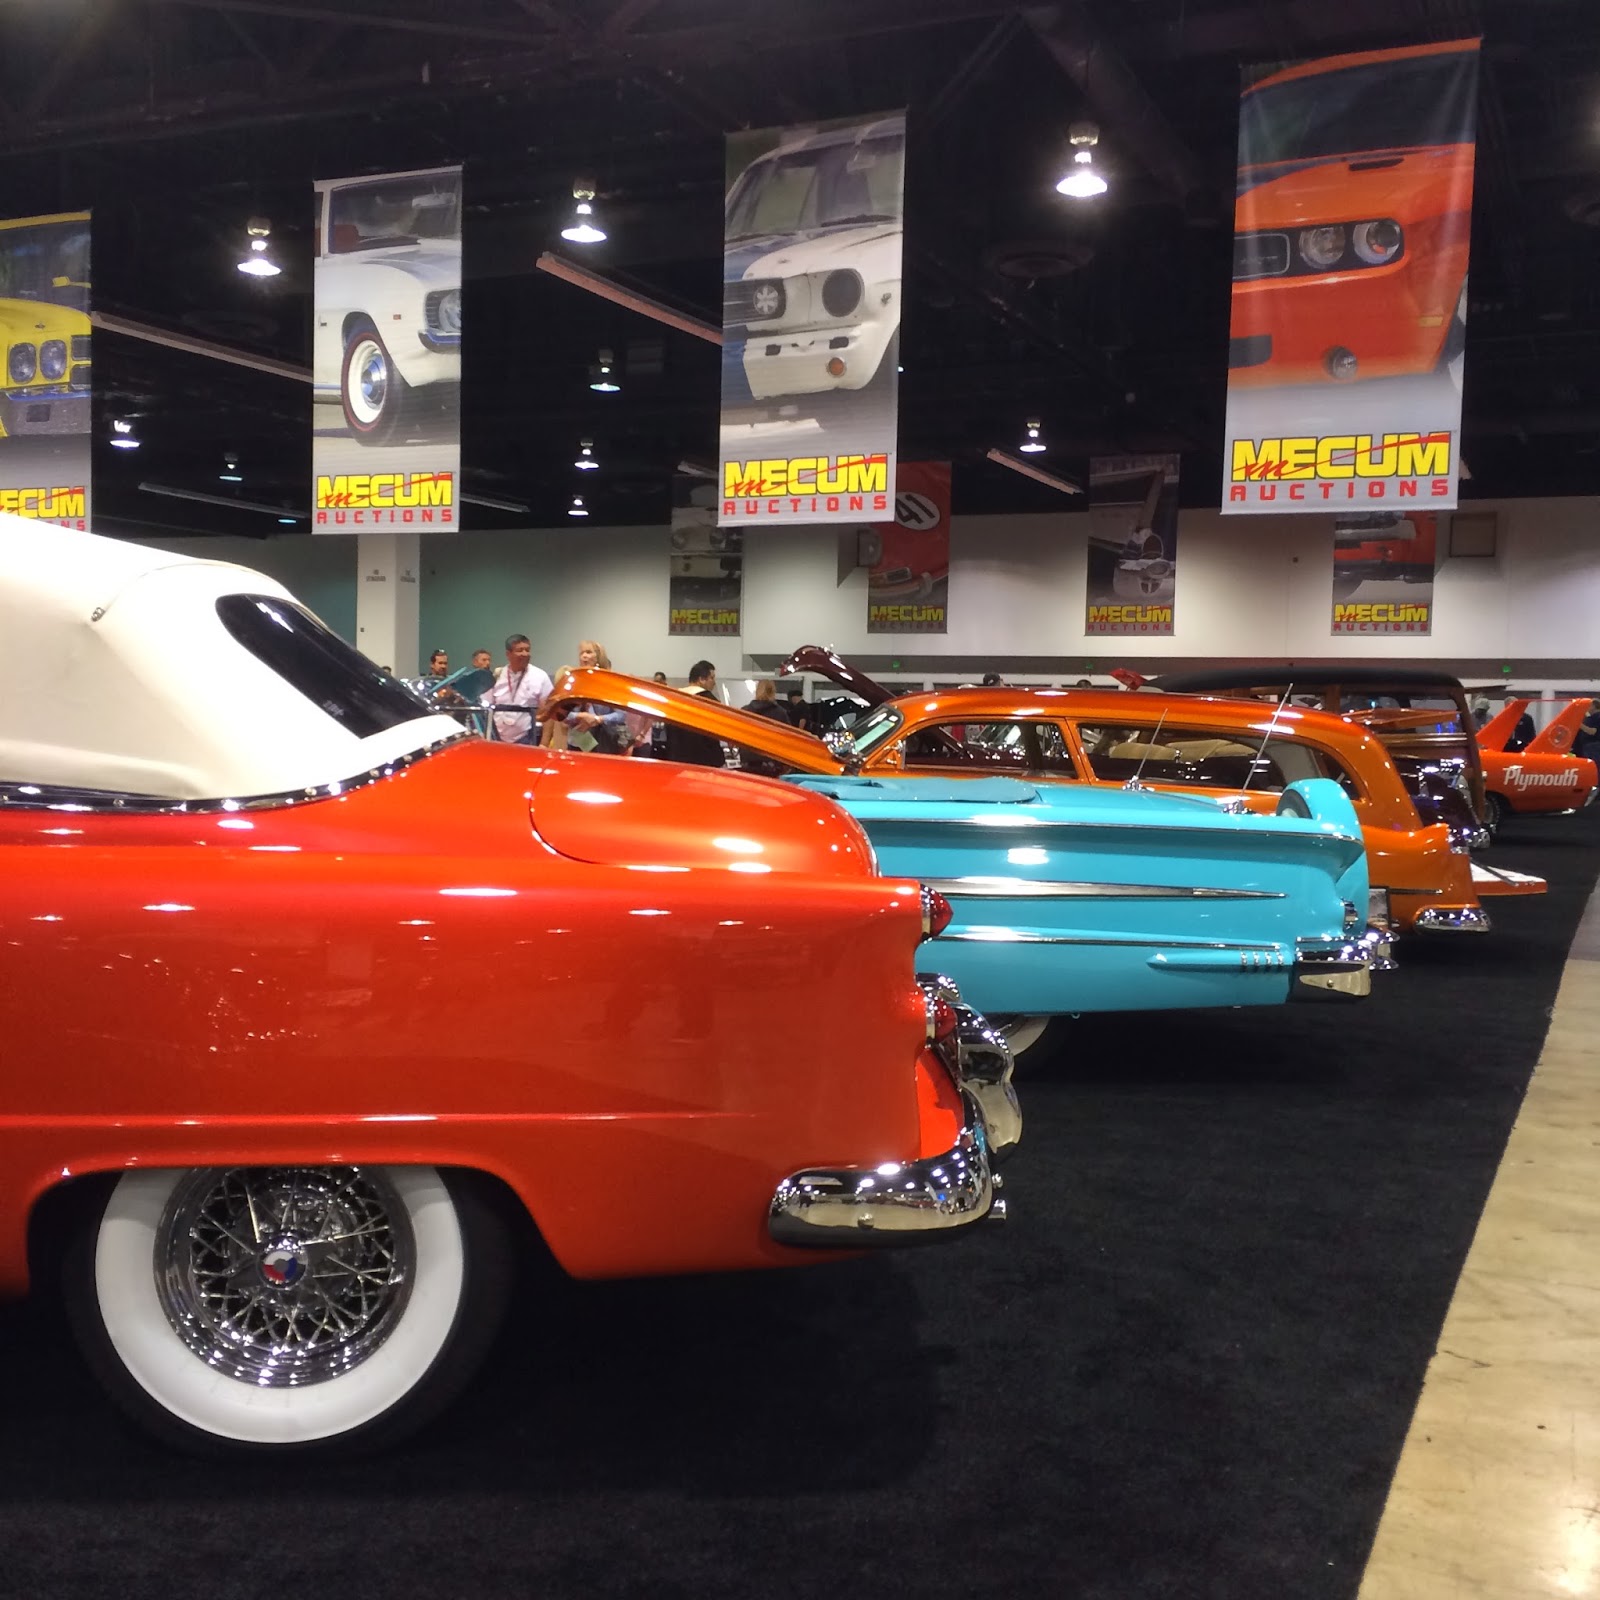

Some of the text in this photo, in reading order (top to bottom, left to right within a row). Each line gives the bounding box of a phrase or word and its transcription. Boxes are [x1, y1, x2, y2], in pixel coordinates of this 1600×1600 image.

[1231, 431, 1451, 482] MECUM
[724, 453, 887, 498] MECUM
[317, 472, 453, 509] MECUM
[1230, 479, 1449, 501] AUCTIONS
[723, 495, 887, 515] AUCTIONS
[317, 509, 452, 524] AUCTIONS
[671, 608, 738, 624] MECUM
[870, 605, 944, 621] MECUM
[1088, 605, 1172, 623] MECUM
[1335, 603, 1428, 622] MECUM
[1088, 623, 1172, 631] AUCTIONS
[1333, 622, 1428, 631] AUCTIONS
[1503, 765, 1579, 791] Plymouth
